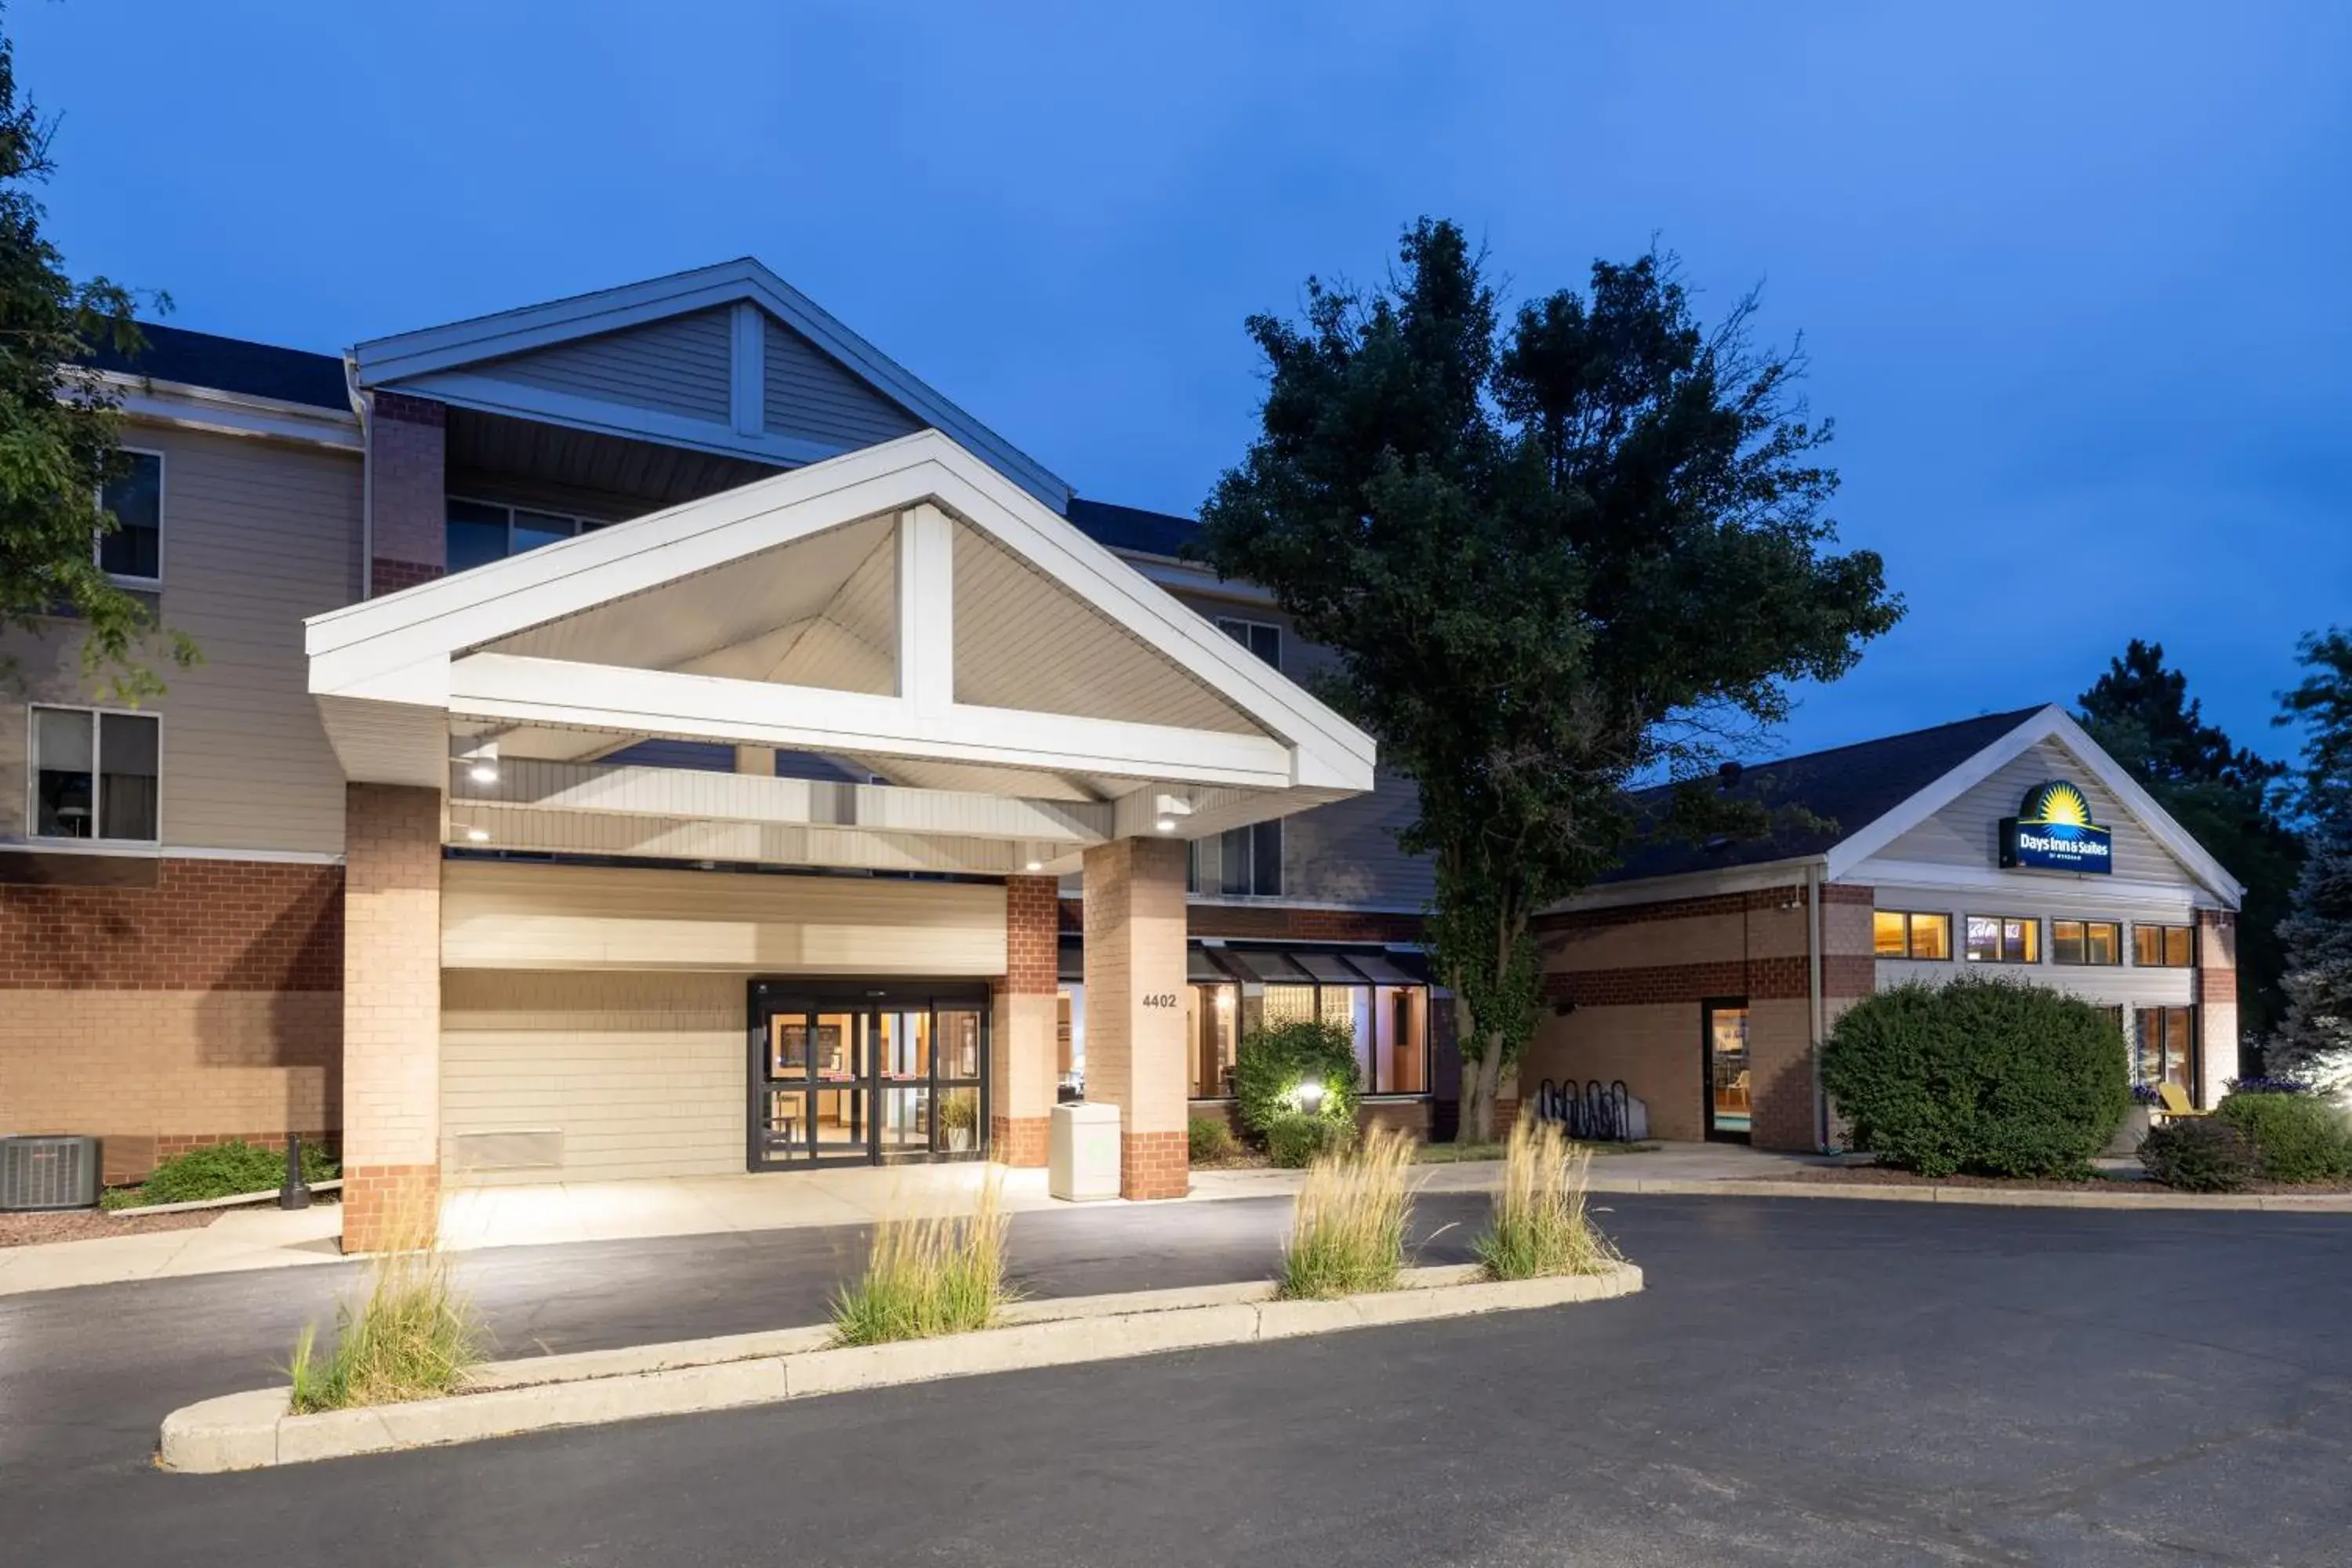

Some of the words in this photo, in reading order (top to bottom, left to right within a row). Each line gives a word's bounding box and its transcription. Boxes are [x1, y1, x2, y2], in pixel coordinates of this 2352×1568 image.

[2020, 833, 2049, 851] Days
[2050, 837, 2070, 852] Inn
[2078, 841, 2108, 855] Suites
[1143, 994, 1177, 1008] 4402
